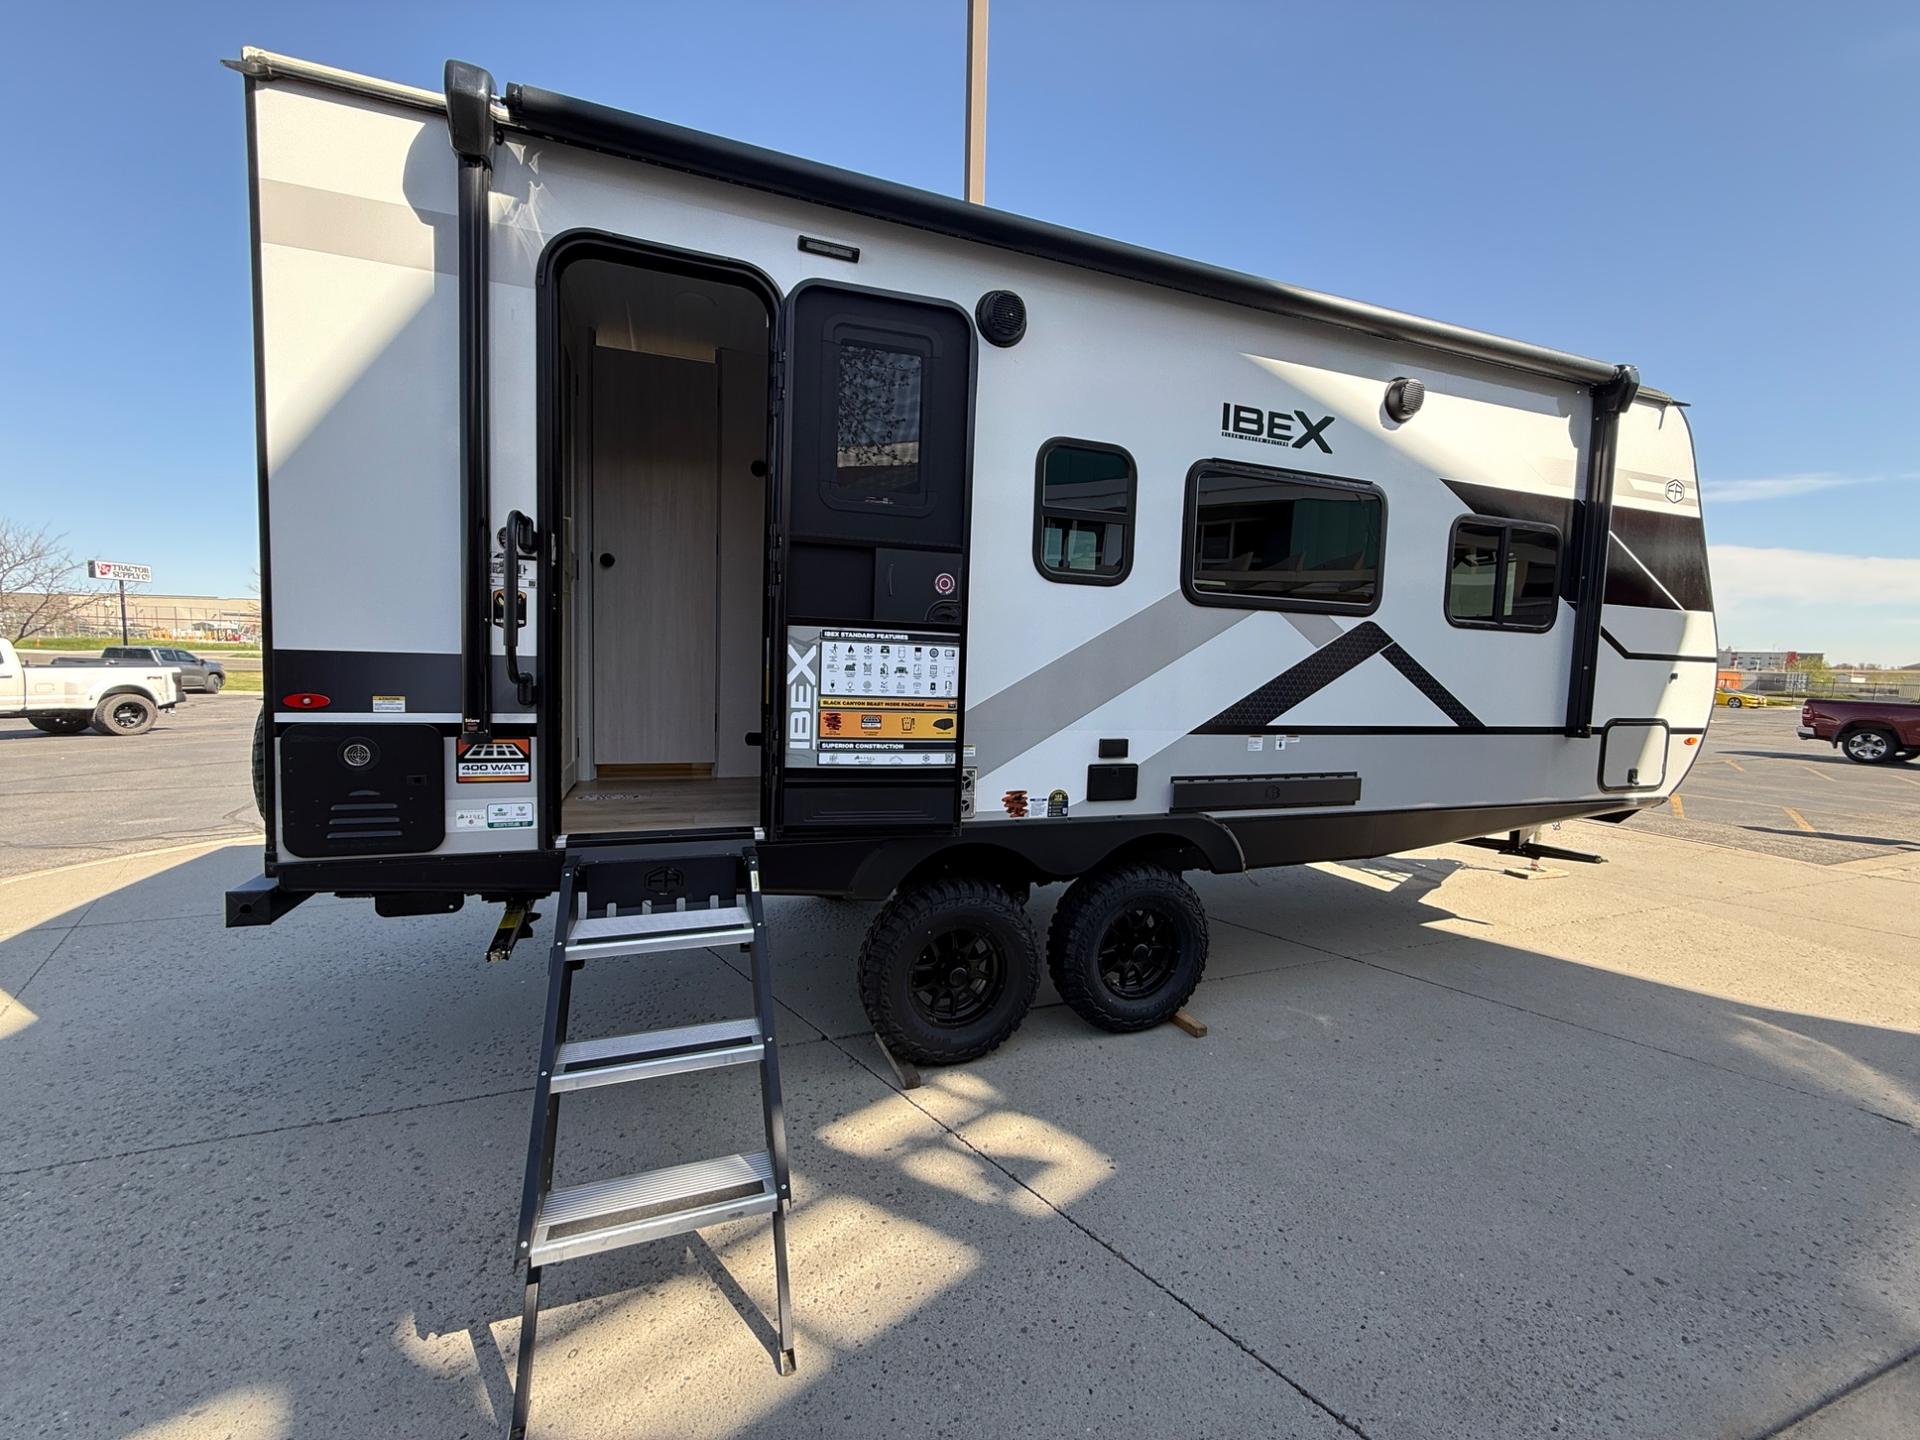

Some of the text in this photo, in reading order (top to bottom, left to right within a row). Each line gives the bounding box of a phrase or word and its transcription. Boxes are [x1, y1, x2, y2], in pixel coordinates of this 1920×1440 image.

[1221, 402, 1336, 454] IBEX
[112, 564, 150, 574] TRACTOR
[112, 571, 141, 580] SUPPLY
[841, 632, 876, 640] STANDARD
[876, 633, 909, 641] FEATURES
[787, 643, 817, 749] IBEX
[490, 763, 526, 771] WATT
